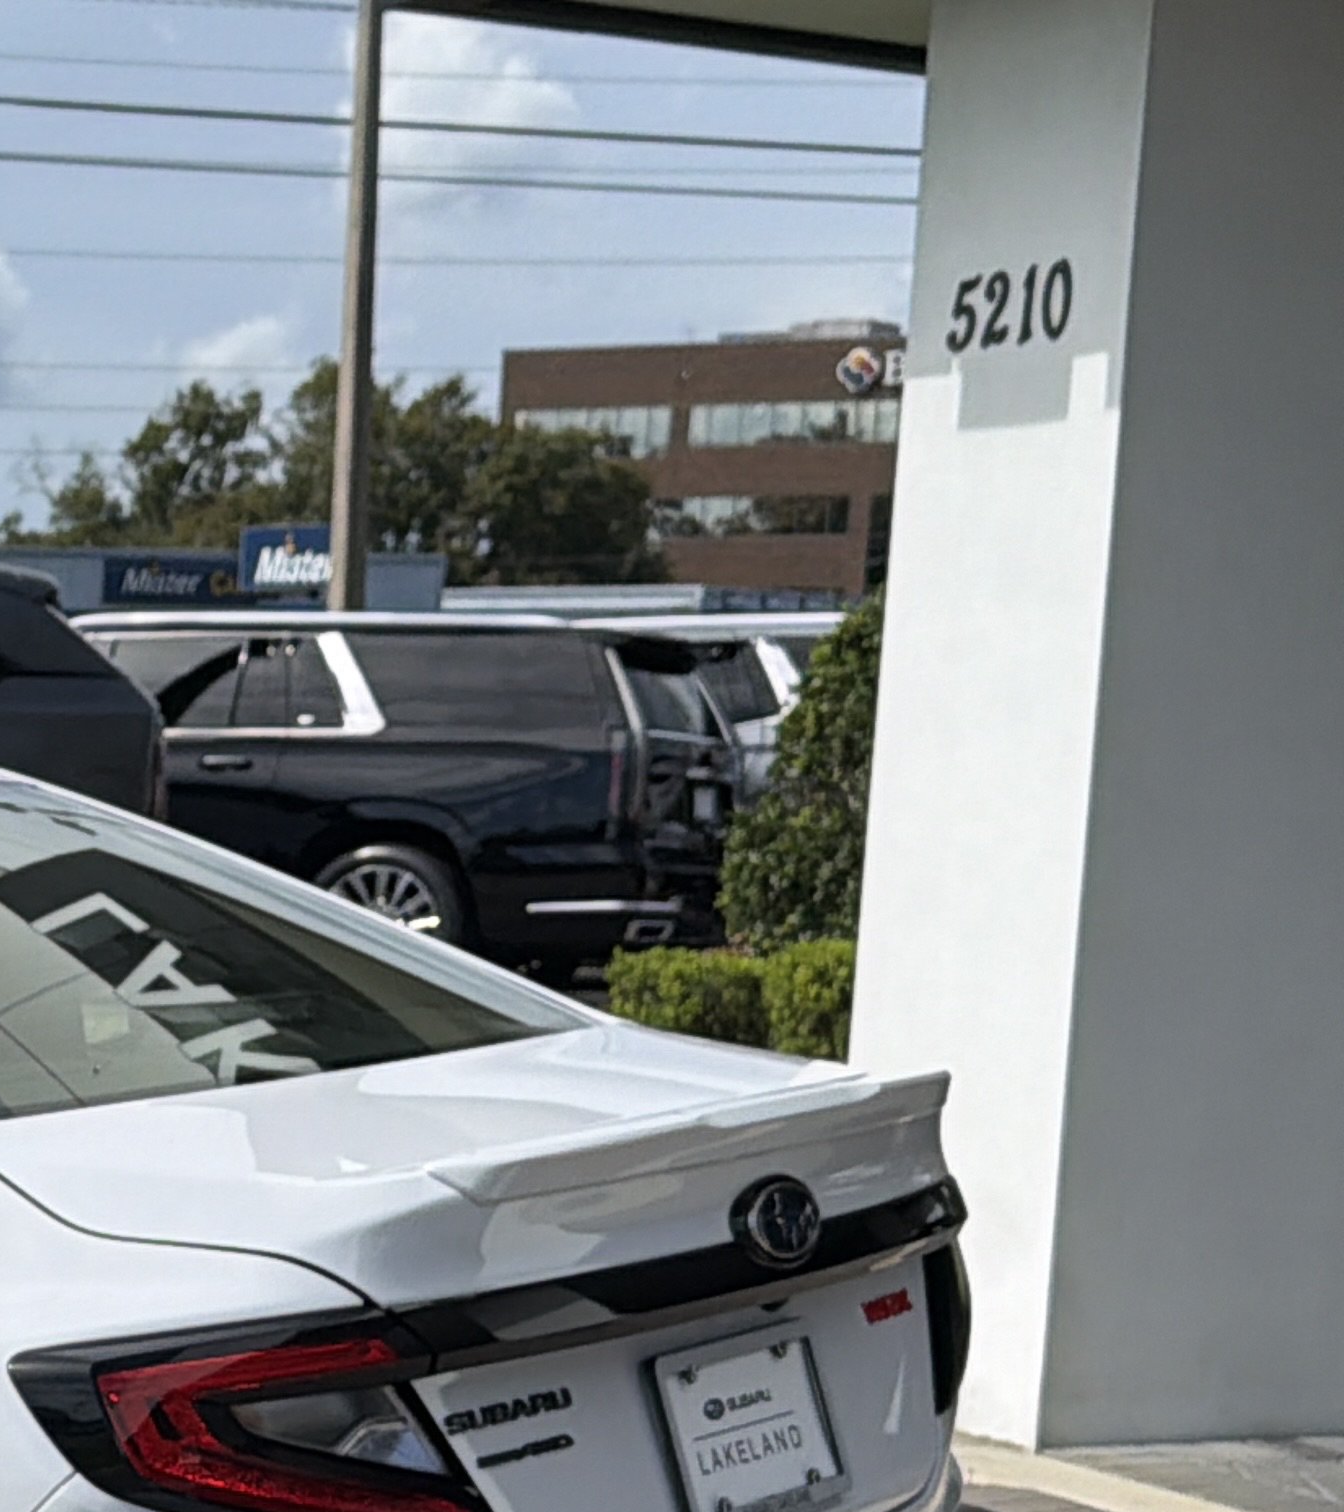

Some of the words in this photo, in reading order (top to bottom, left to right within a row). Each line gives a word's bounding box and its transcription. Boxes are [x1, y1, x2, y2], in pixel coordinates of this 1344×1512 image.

[945, 256, 1072, 354] 5210
[444, 1386, 573, 1436] SUBARU
[696, 1423, 803, 1476] LAKELAND
